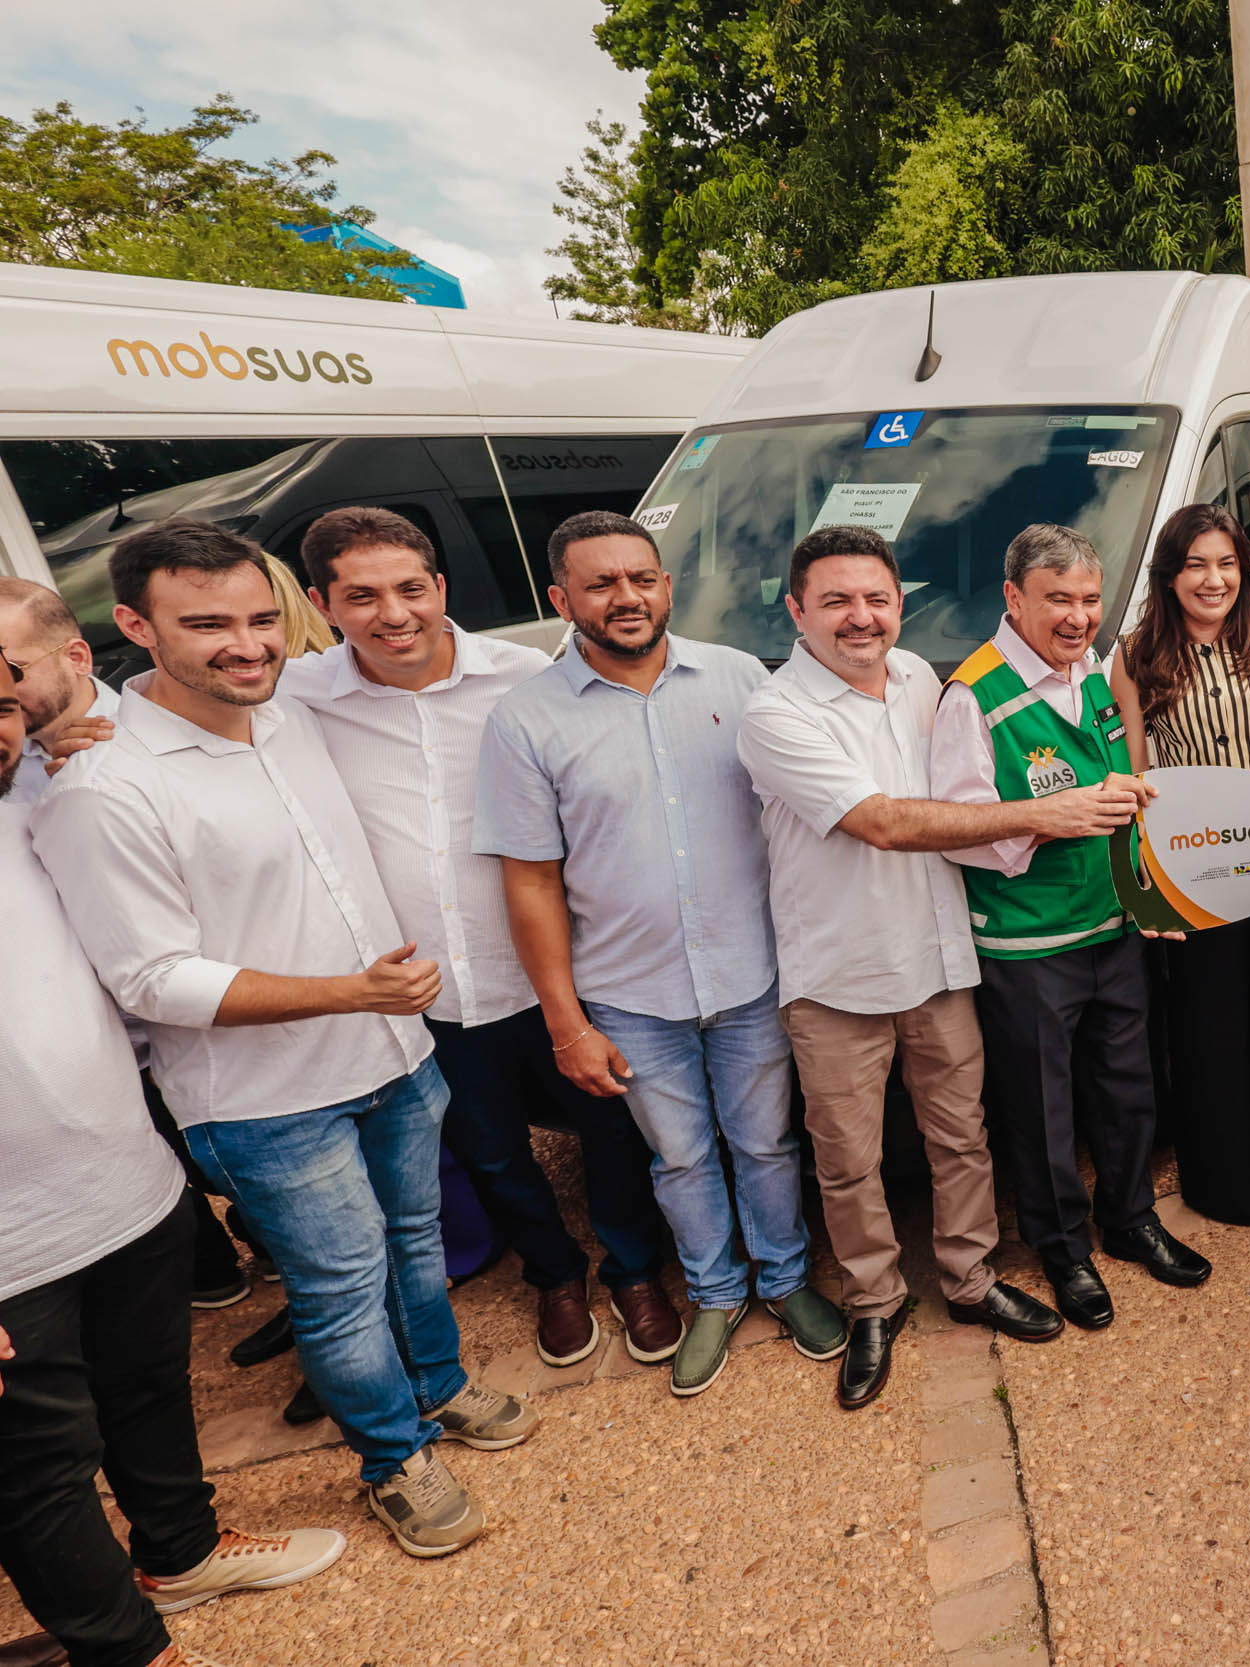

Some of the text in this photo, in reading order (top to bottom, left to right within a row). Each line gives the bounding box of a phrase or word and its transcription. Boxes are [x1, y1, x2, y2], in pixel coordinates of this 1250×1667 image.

[107, 331, 373, 385] mobsuas
[639, 510, 673, 527] 0128
[1030, 768, 1074, 792] SUAS
